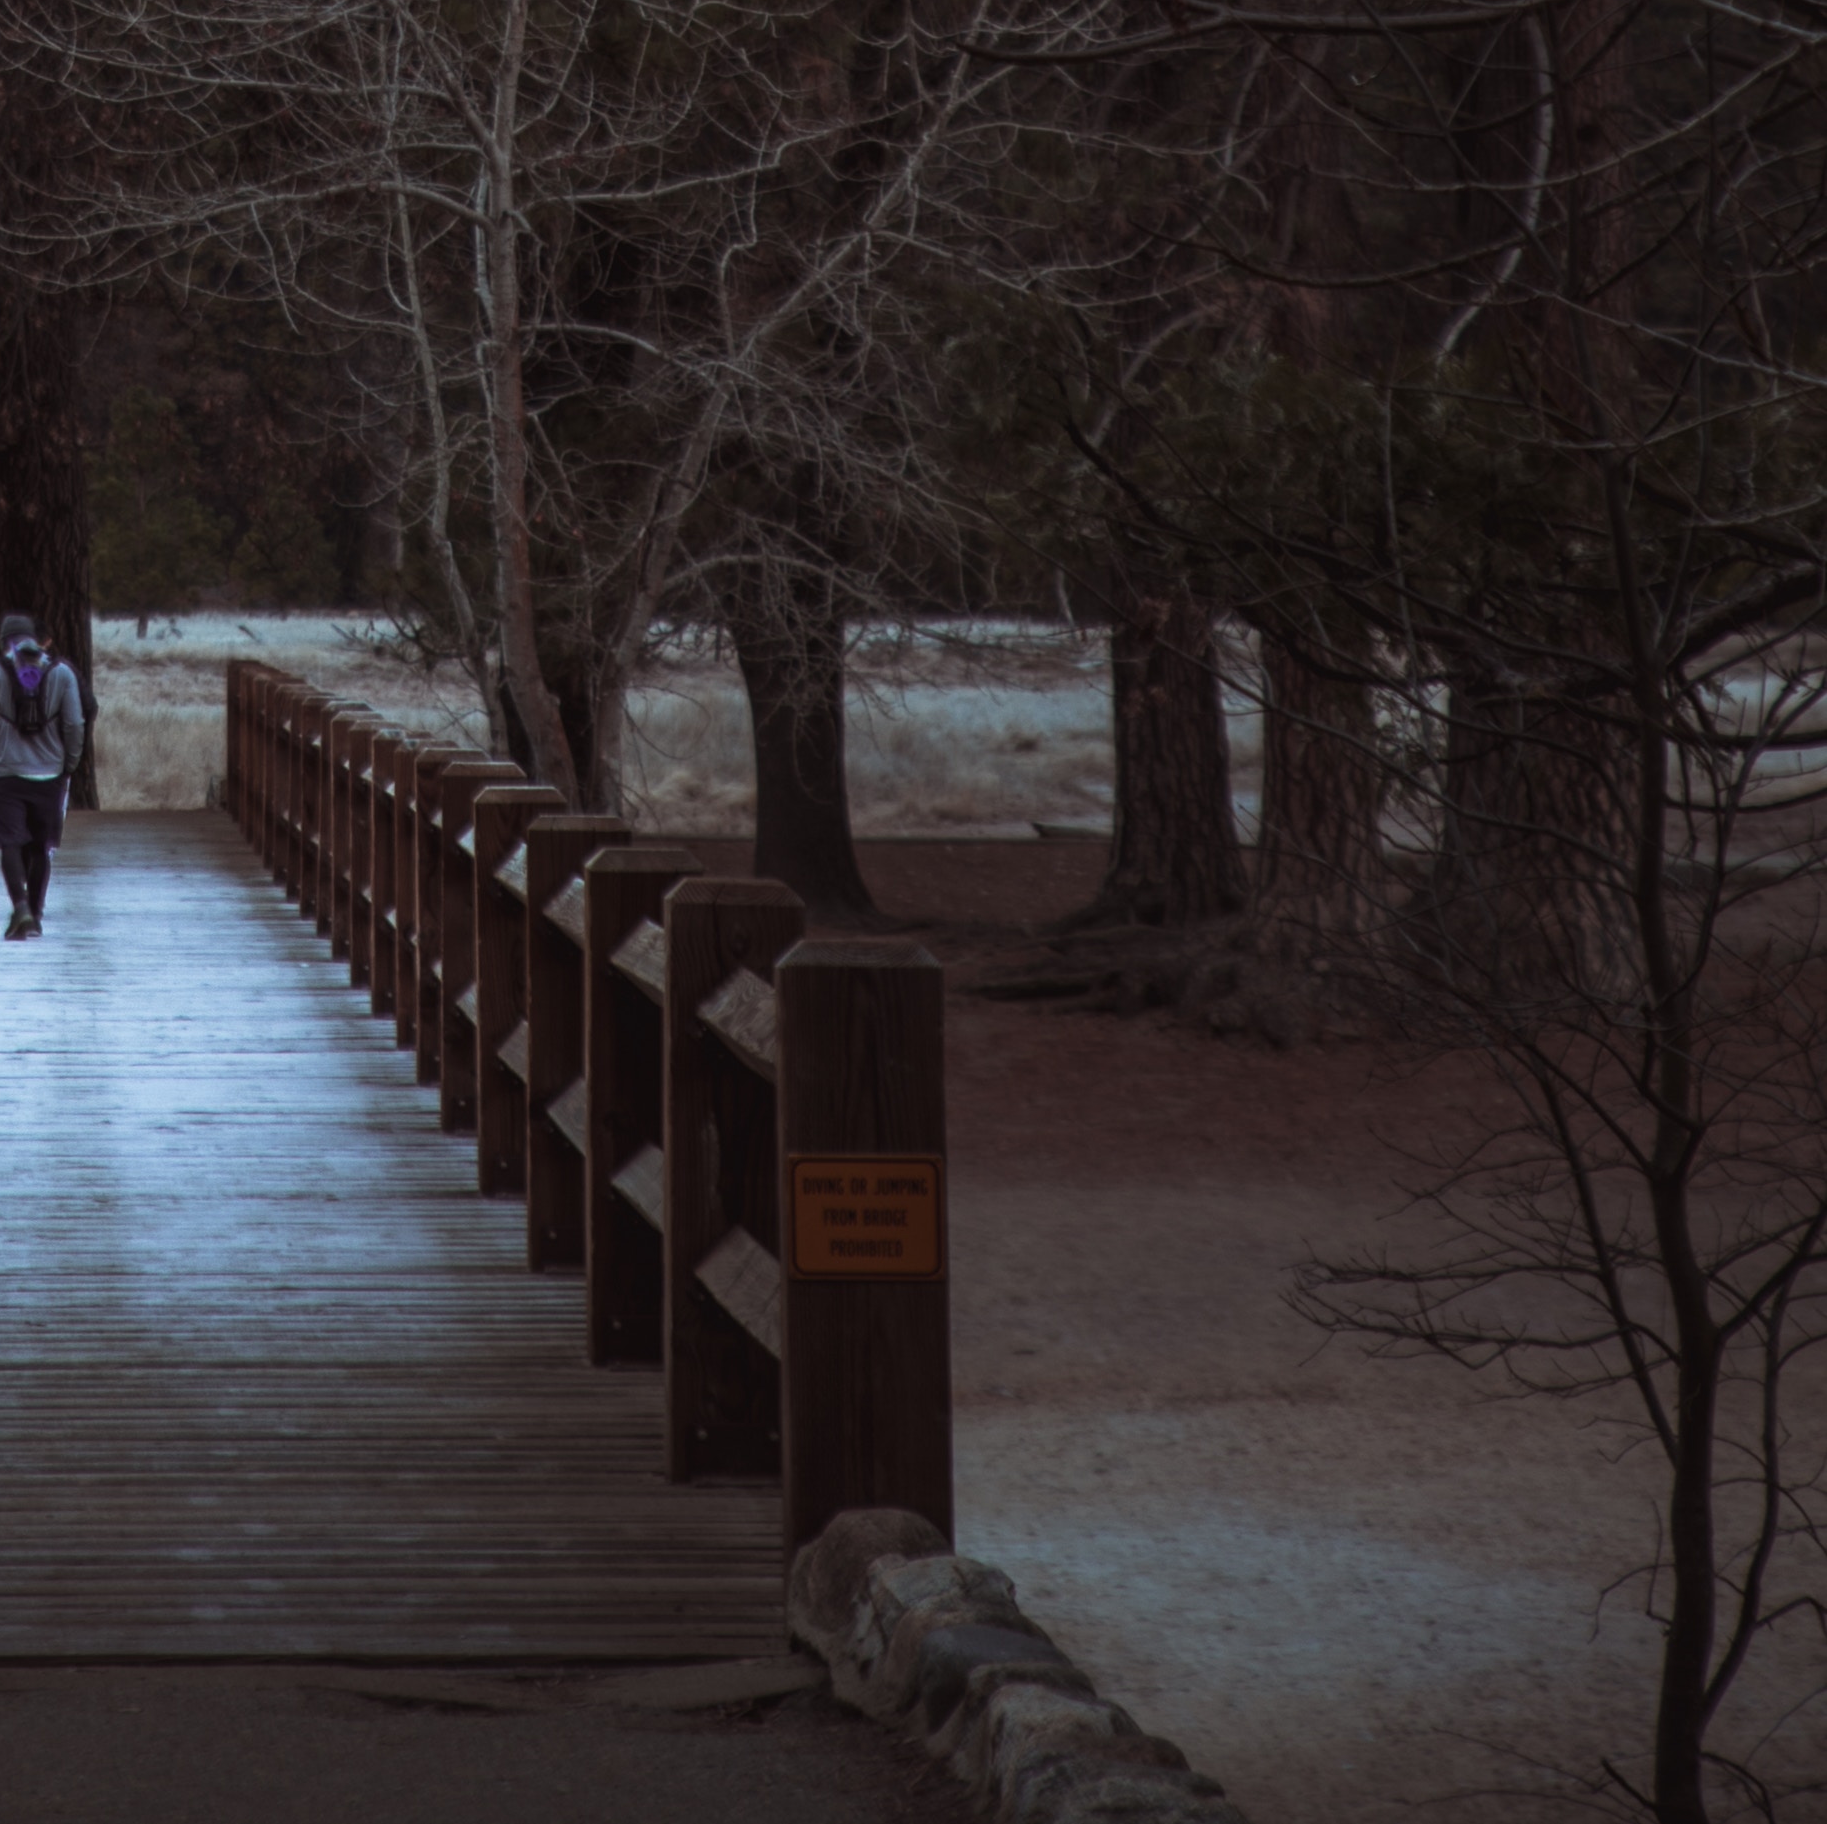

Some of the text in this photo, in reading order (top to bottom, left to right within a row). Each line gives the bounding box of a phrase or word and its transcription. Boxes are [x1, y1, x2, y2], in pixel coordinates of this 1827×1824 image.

[803, 1177, 928, 1196] DIVING OR JUMPING
[823, 1209, 908, 1227] FROM BRIDGE
[830, 1239, 903, 1258] PROHIBITED
